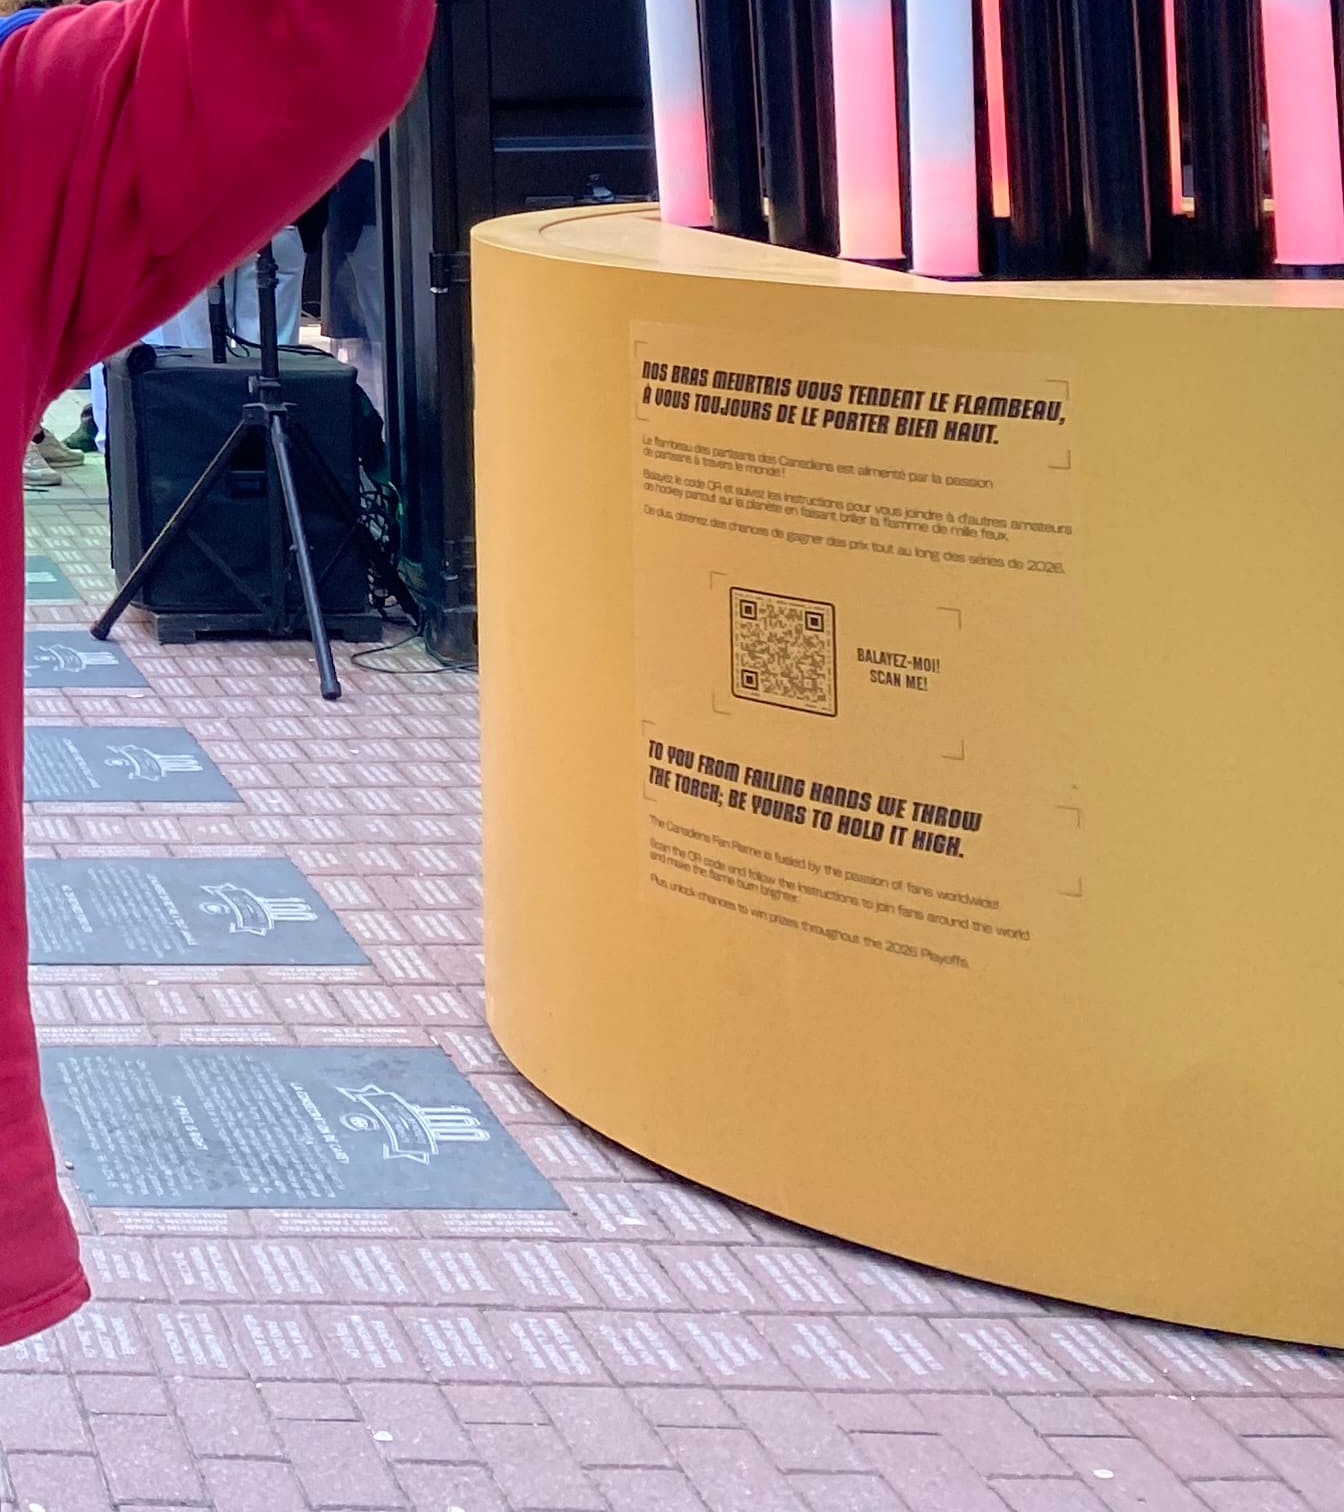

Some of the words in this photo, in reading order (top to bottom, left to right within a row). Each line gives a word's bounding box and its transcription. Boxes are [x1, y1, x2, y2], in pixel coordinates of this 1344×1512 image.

[642, 361, 668, 381] NOS
[671, 365, 709, 386] BRAS
[713, 371, 792, 397] MEURTRIS
[797, 380, 844, 402] VOUS
[849, 385, 925, 410] TENDENT
[929, 392, 949, 412] LE
[954, 394, 1066, 425] FLAMBEAU,
[643, 384, 652, 404] À
[655, 388, 690, 410] VOUS
[694, 394, 772, 421] TOUJOURS
[776, 404, 797, 424] DE
[801, 407, 820, 426] LE
[823, 410, 890, 434] PORTER
[895, 417, 939, 439] BIEN
[943, 421, 999, 444] HAUT.
[909, 472, 928, 483] par
[946, 475, 993, 488] passion
[846, 501, 872, 514] pour
[875, 505, 902, 517] vous
[1010, 520, 1072, 535] amateurs
[857, 647, 941, 673] BALAYEZ-MOI!
[870, 670, 901, 687] SCAN
[906, 675, 928, 691] ME!
[648, 740, 663, 760] TO
[667, 746, 694, 769] YOU
[698, 754, 740, 782] FROM
[744, 767, 806, 798] FAILING
[810, 782, 872, 811] HANDS
[877, 796, 907, 819] WE
[912, 802, 983, 831] THROW
[649, 766, 672, 789] THE
[675, 773, 723, 807] TORCH;
[728, 789, 748, 810] BE
[752, 795, 807, 825] YOURS
[812, 809, 832, 830] TO
[837, 815, 884, 841] HOLD
[889, 825, 908, 846] IT
[912, 830, 964, 858] HIGH.
[845, 871, 889, 888] passion
[907, 881, 933, 896] fans
[861, 898, 874, 909] to
[898, 904, 924, 921] fans
[927, 912, 969, 930] around
[972, 920, 993, 934] the
[996, 925, 1030, 941] world
[411, 1105, 494, 1141] 100
